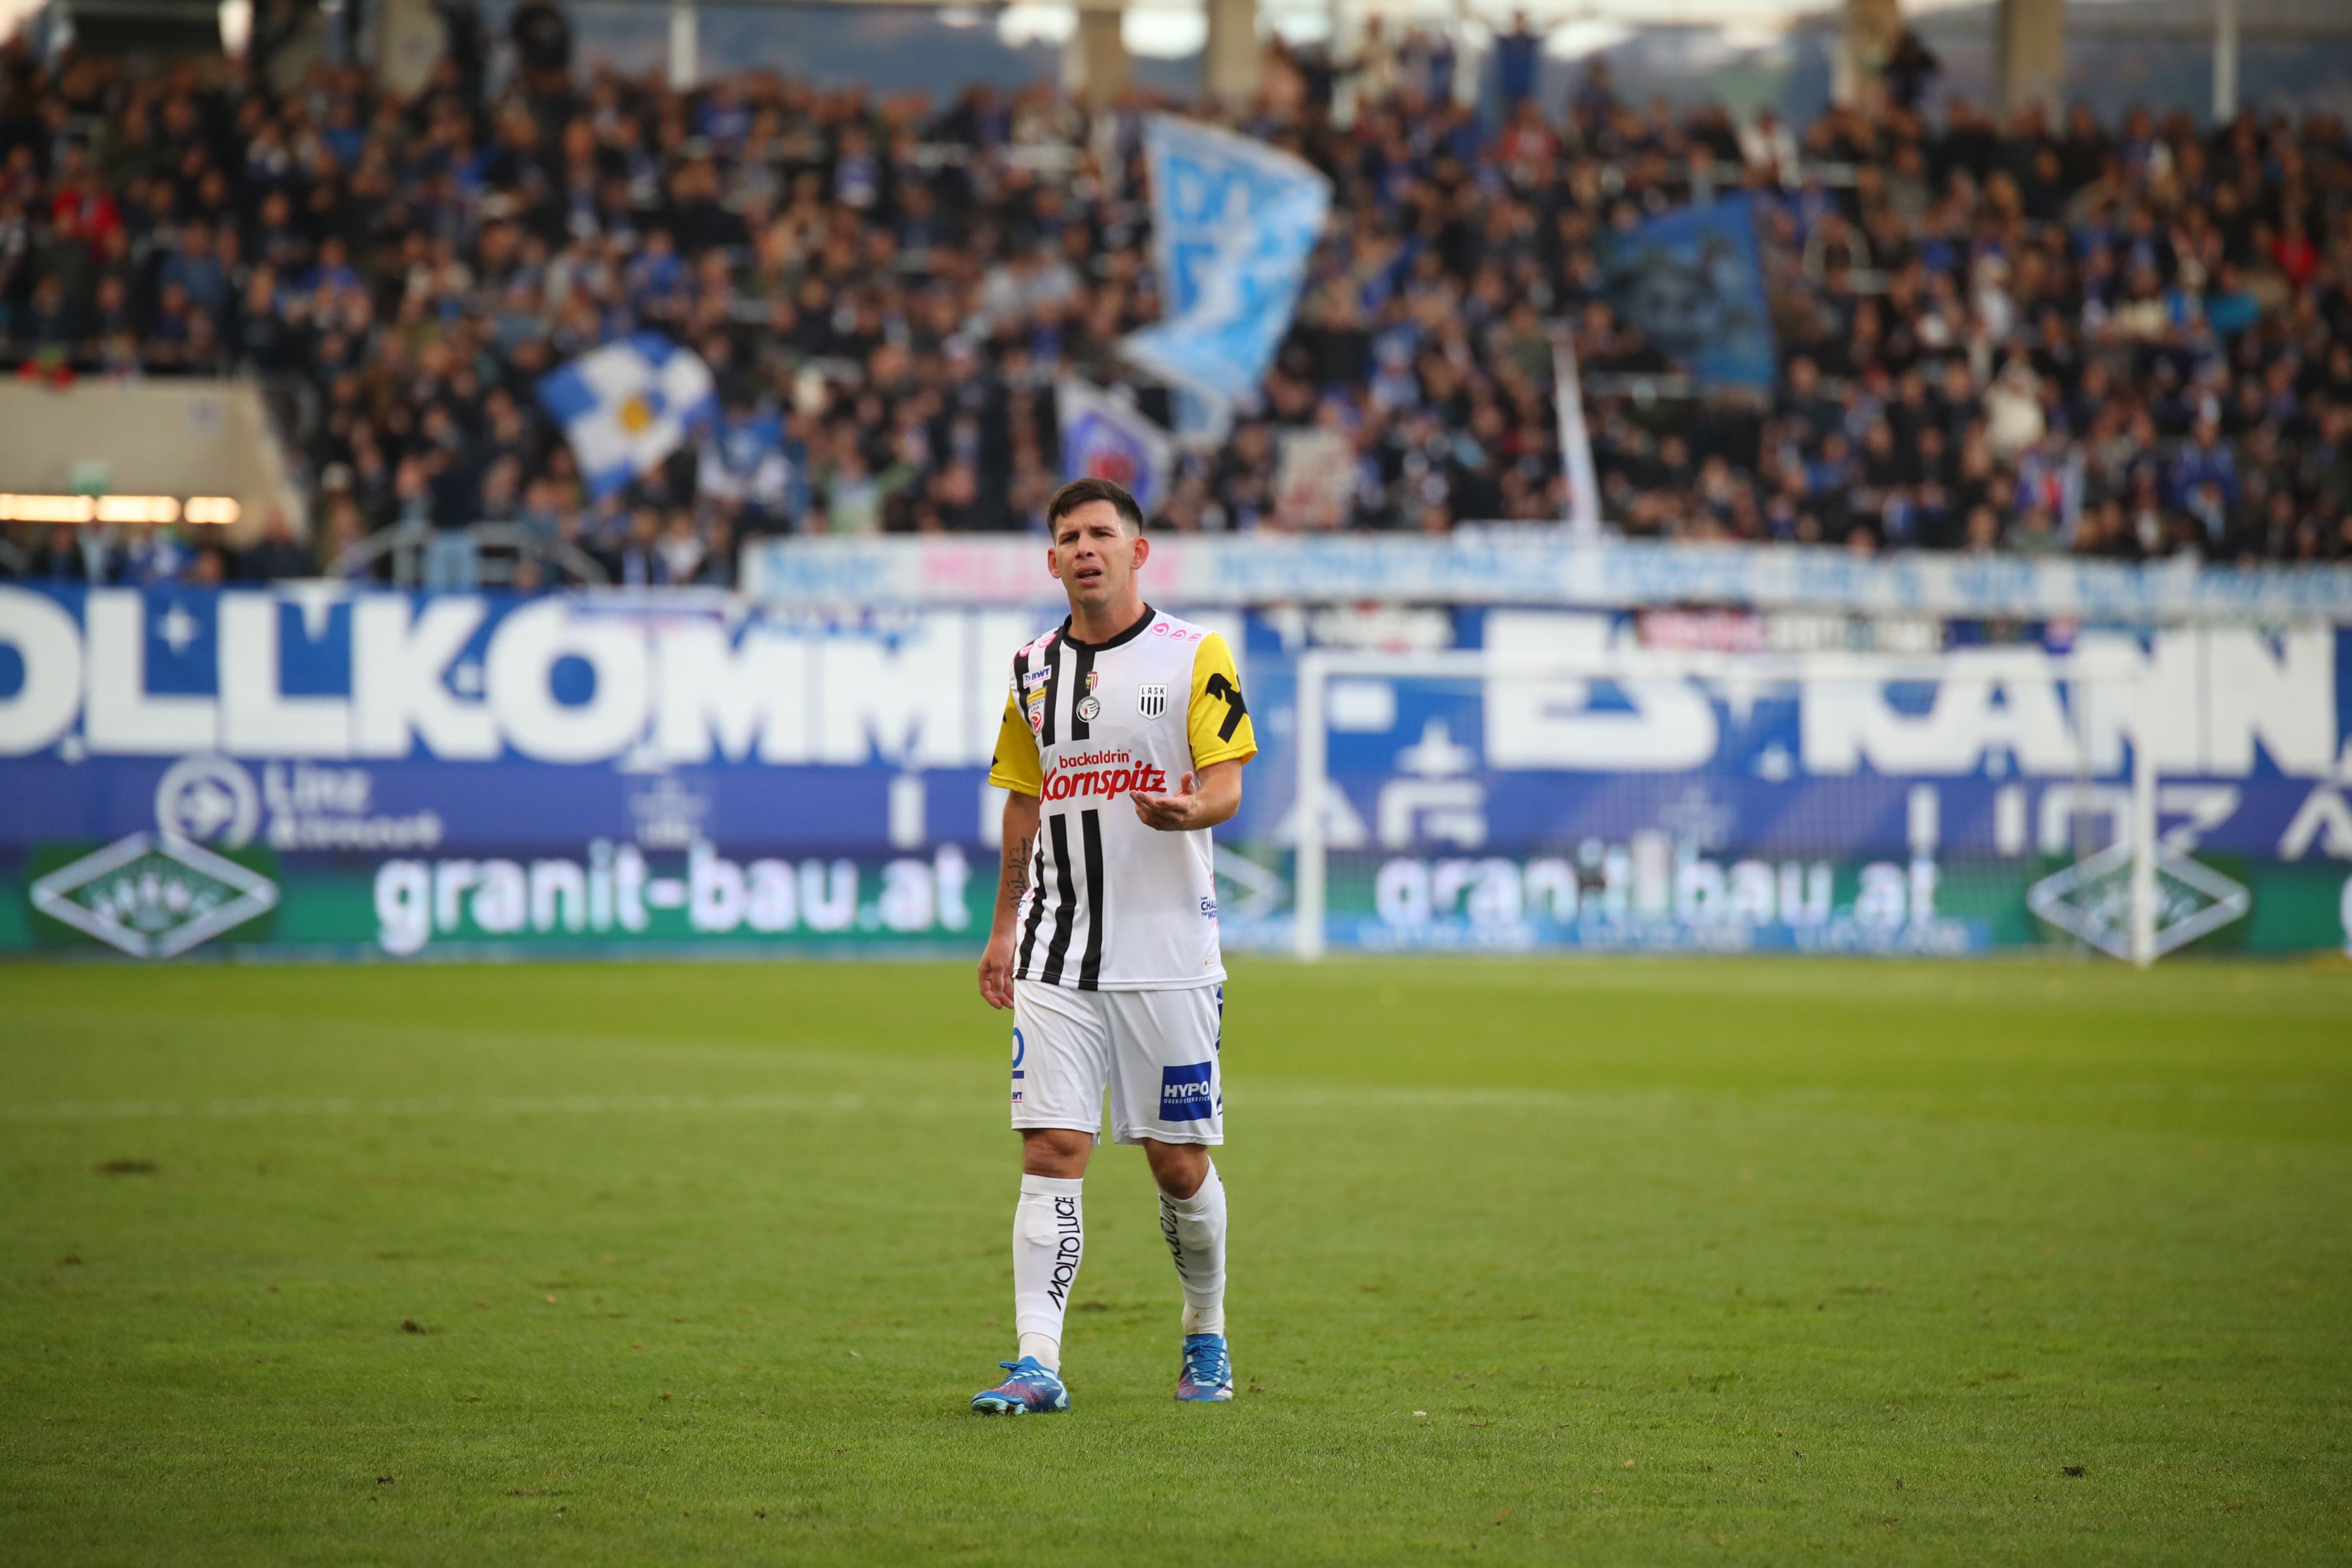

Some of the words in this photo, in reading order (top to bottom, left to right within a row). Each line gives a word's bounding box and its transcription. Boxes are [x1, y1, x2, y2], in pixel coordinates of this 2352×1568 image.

[1031, 668, 1050, 681] BWT
[1141, 687, 1165, 695] LASK
[1483, 609, 1718, 771] ES
[1798, 621, 2336, 778] KANN
[1040, 760, 1167, 805] Kornspitz
[374, 838, 970, 955] granit-bau.at
[1164, 1081, 1209, 1098] HYPO
[1164, 1095, 1210, 1104] OBERÖSTERREICH
[1055, 1196, 1080, 1234] LUCE
[1047, 1236, 1080, 1312] MOLTO
